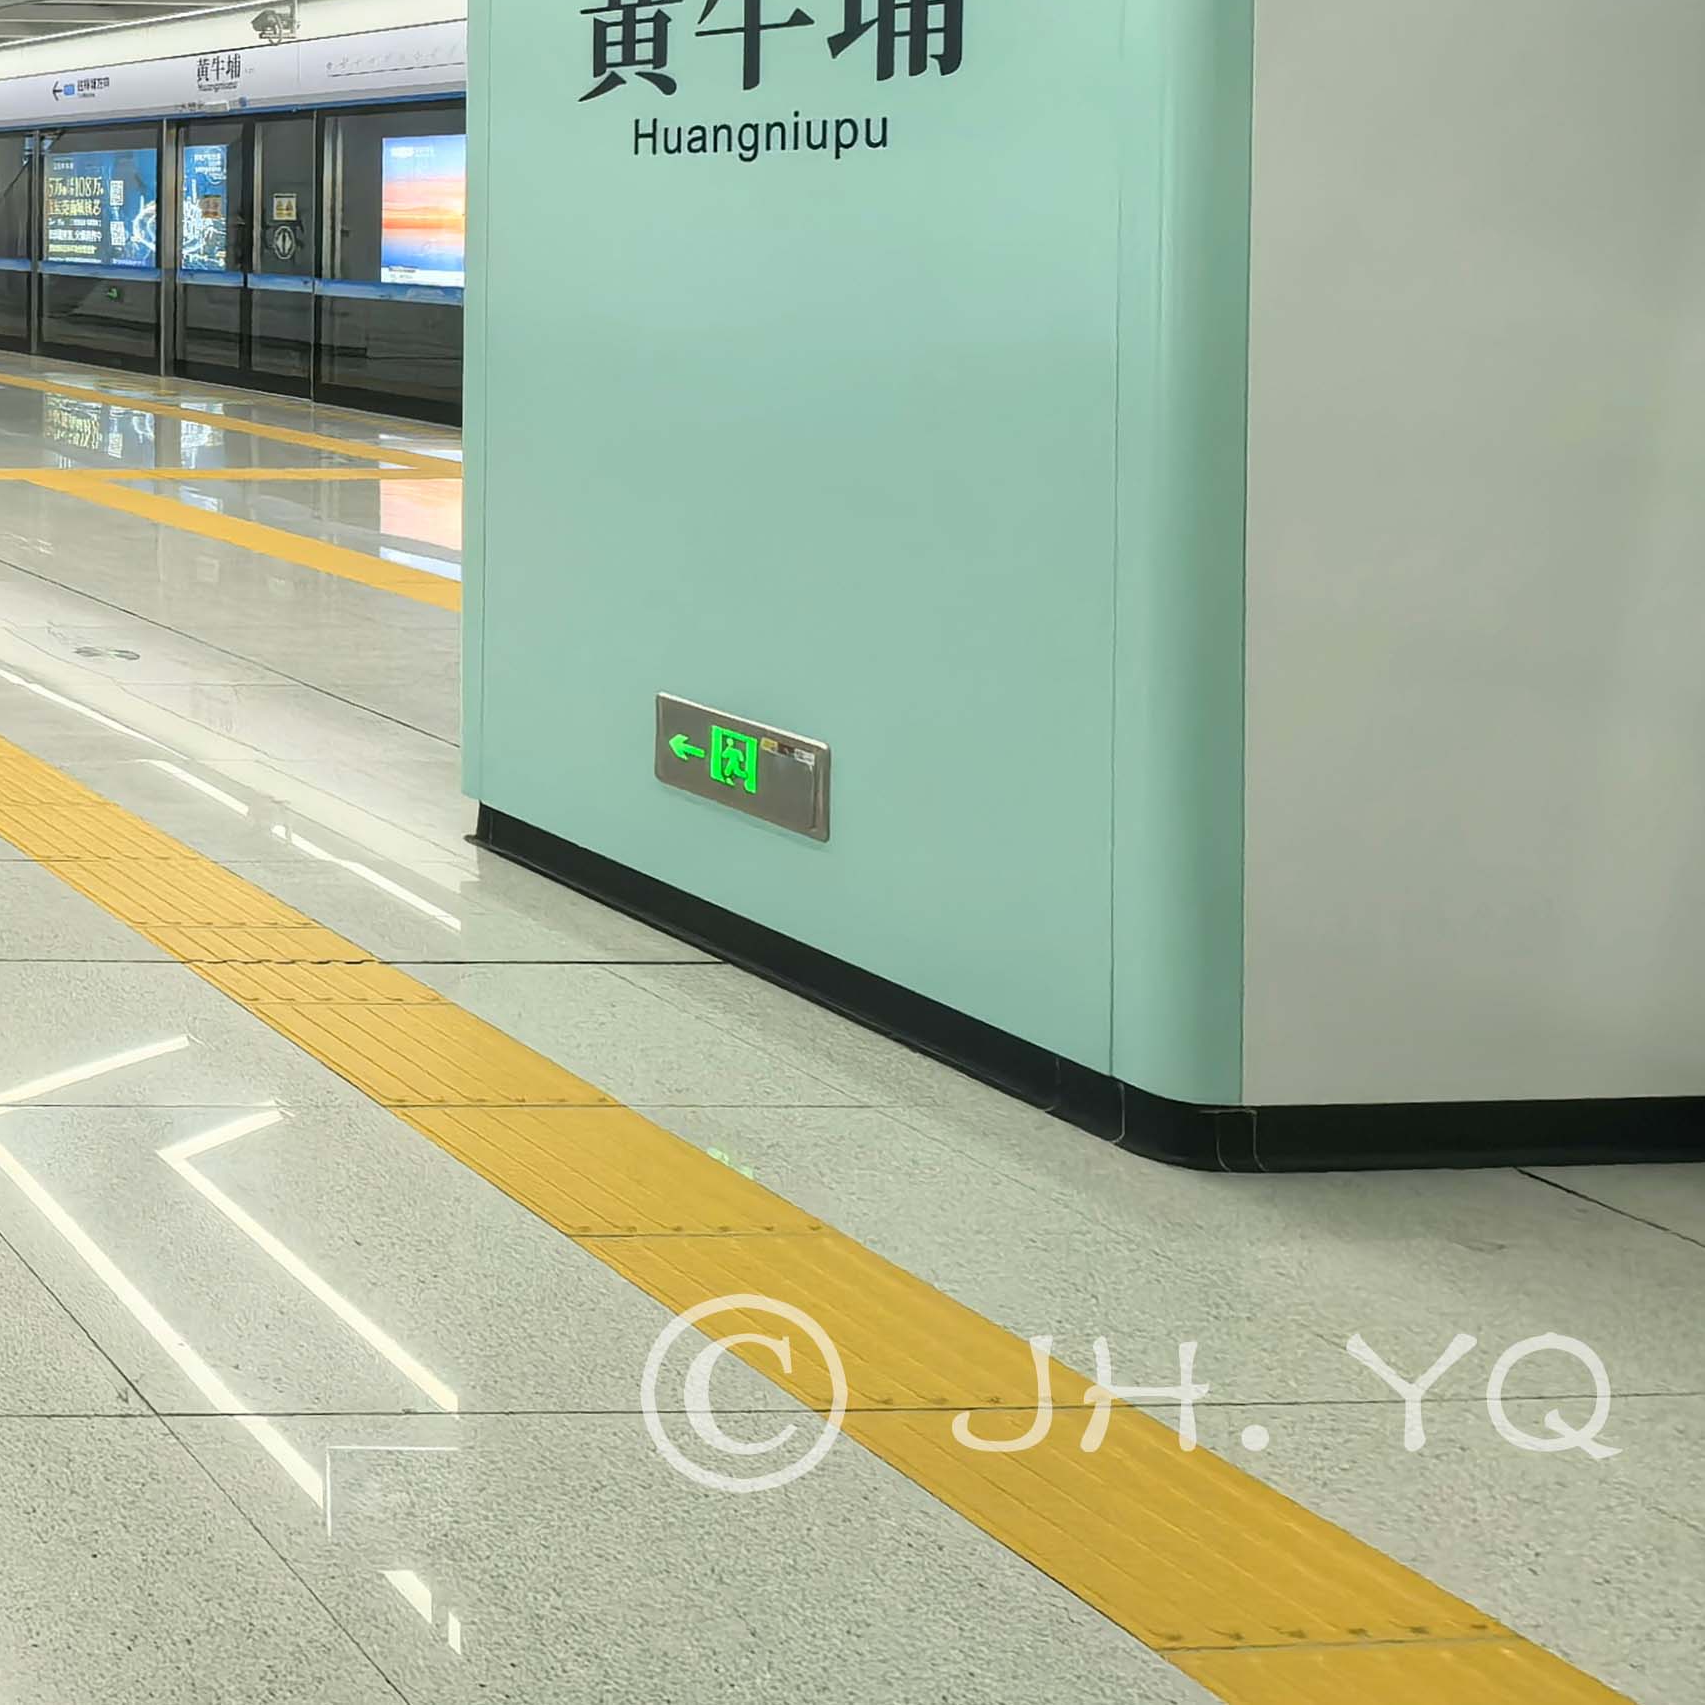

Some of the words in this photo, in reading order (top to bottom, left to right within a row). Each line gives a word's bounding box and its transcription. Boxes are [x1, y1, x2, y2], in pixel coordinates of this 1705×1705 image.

[196, 53, 241, 82] 黄牛埔
[632, 110, 889, 162] Huangniupu
